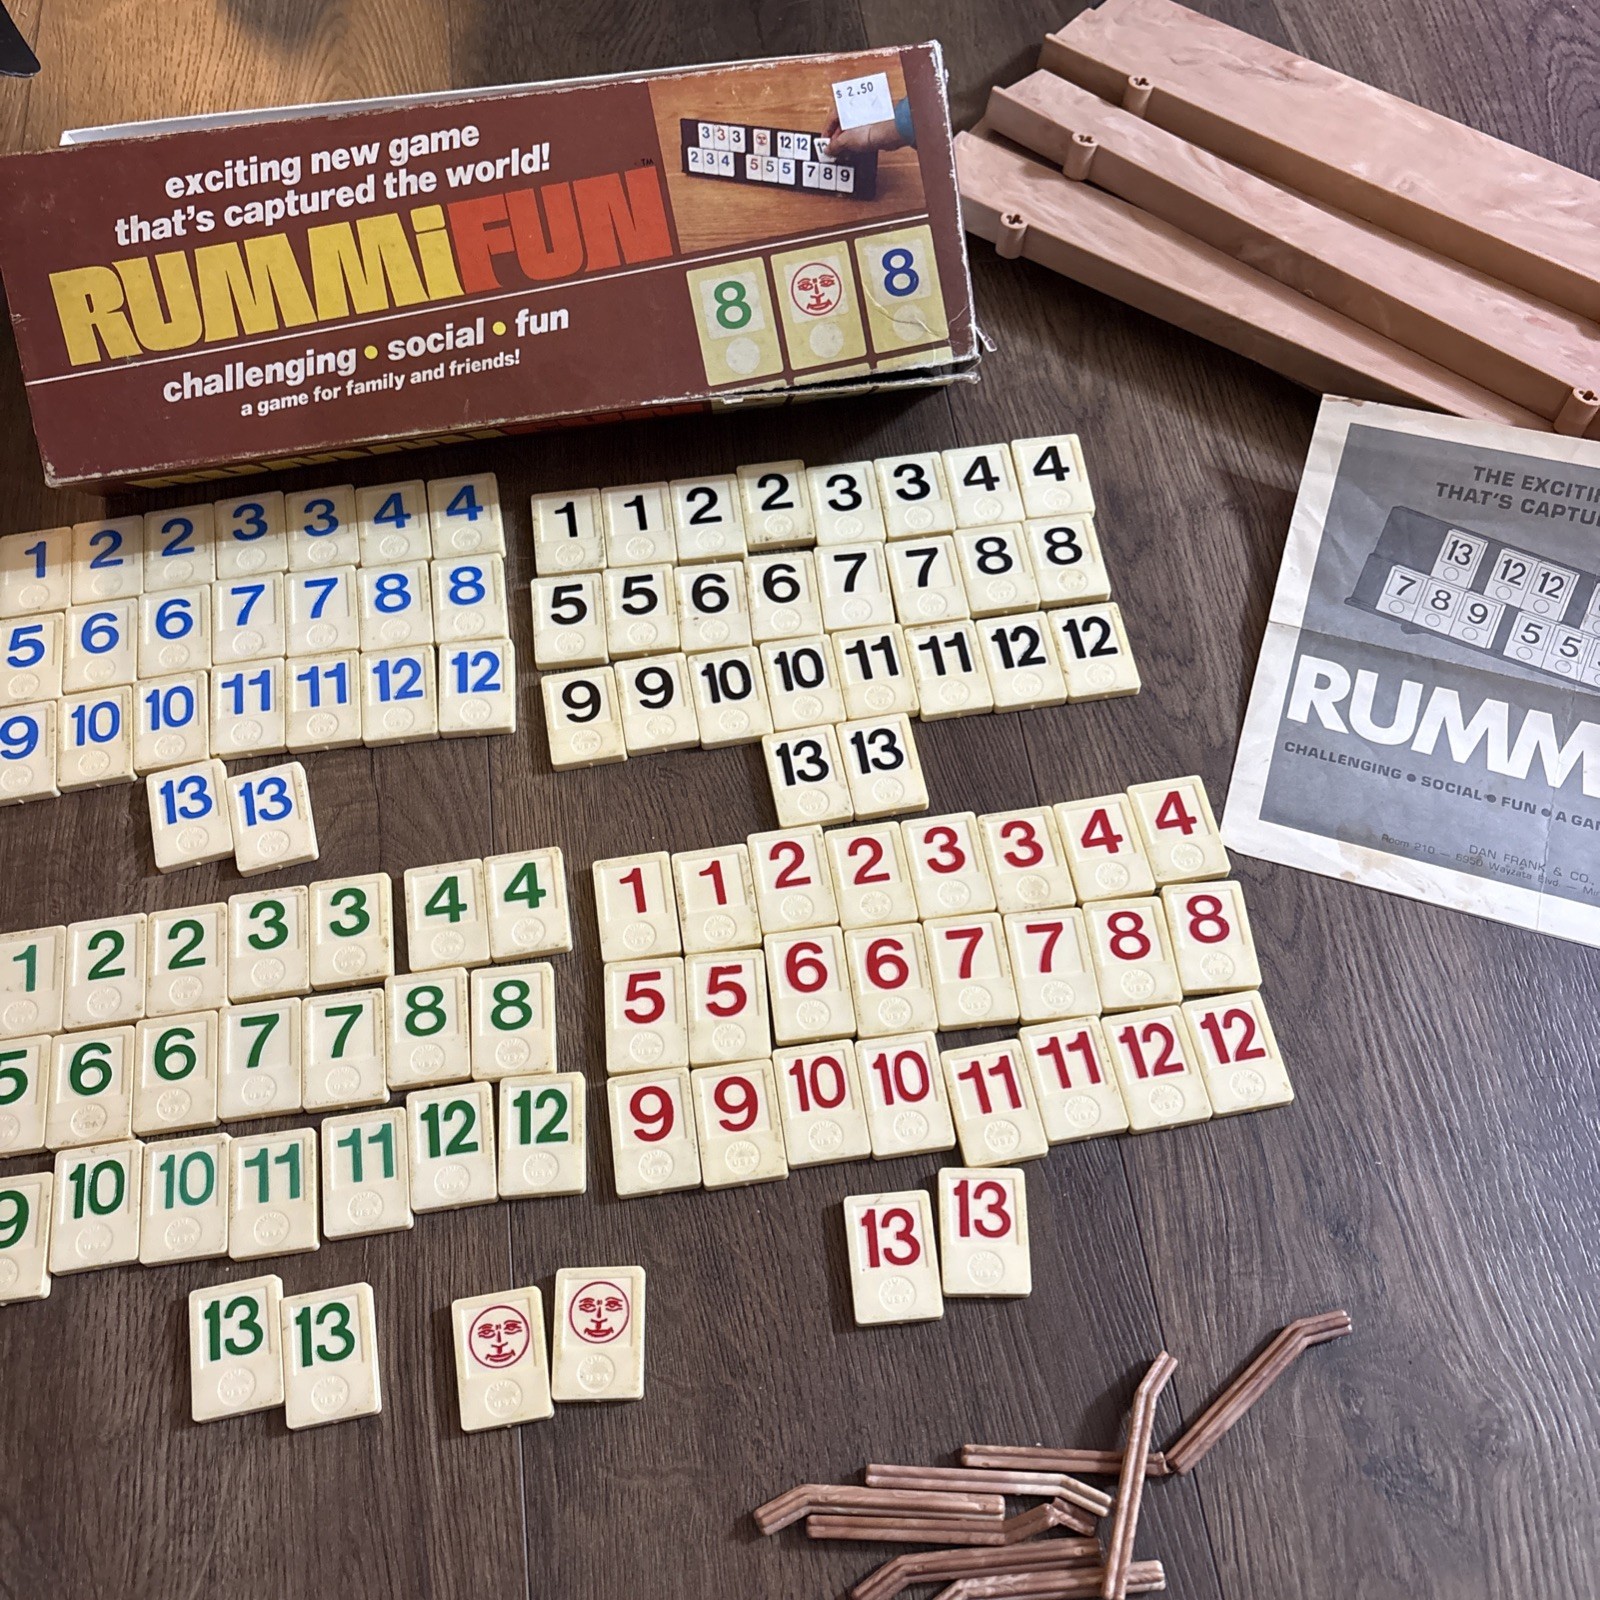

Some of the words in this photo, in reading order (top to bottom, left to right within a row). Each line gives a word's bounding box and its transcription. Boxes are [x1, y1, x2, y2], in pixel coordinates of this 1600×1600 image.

[847, 82, 874, 97] 2.50
[165, 156, 301, 198] exciting
[311, 142, 381, 174] new
[389, 126, 480, 166] game
[691, 151, 699, 163] 2
[706, 153, 715, 165] 3
[721, 155, 730, 167] 4
[750, 158, 759, 171] 5
[766, 161, 775, 172] 5
[782, 162, 791, 174] 5
[807, 165, 816, 178] 7
[823, 167, 833, 180] 8
[840, 169, 850, 182] 9
[702, 126, 710, 139] 3
[717, 128, 726, 141] 3
[732, 130, 741, 143] 3
[779, 136, 792, 149] 12
[796, 138, 808, 151] 12
[115, 206, 216, 245] that's
[224, 174, 376, 227] captured
[383, 169, 438, 199] the
[446, 143, 550, 187] world!
[714, 281, 752, 330] 8
[882, 248, 920, 297] 8
[164, 349, 357, 403] challenging
[388, 317, 485, 360] social
[515, 309, 569, 338] fun
[241, 404, 253, 417] a
[258, 393, 309, 417] game
[313, 386, 342, 403] for
[346, 372, 406, 397] family
[410, 363, 445, 385] and
[449, 349, 520, 377] friends!
[554, 501, 578, 538] 1
[623, 494, 648, 531] 1
[686, 486, 723, 525] 2
[757, 473, 794, 511] 2
[826, 474, 862, 512] 3
[893, 463, 931, 501] 3
[963, 455, 1000, 491] 4
[1033, 446, 1070, 481] 4
[1437, 482, 1513, 509] THAT'S
[1521, 499, 1600, 527] CAPTU
[1474, 466, 1516, 487] THE
[24, 541, 46, 578] 1
[90, 530, 124, 569] 2
[161, 518, 195, 557] 2
[233, 503, 268, 541] 3
[304, 499, 339, 537] 3
[373, 492, 411, 529] 4
[446, 485, 484, 522] 4
[1447, 540, 1473, 566] 13
[1500, 558, 1527, 587] 12
[1538, 571, 1564, 599] 12
[7, 624, 45, 668] 5
[81, 612, 120, 654] 6
[155, 598, 194, 640] 6
[230, 583, 265, 626] 7
[304, 577, 339, 619] 7
[374, 573, 412, 614] 8
[448, 565, 486, 606] 8
[551, 583, 587, 625] 5
[622, 574, 658, 615] 5
[691, 573, 729, 614] 6
[763, 563, 800, 604] 6
[833, 552, 867, 593] 7
[905, 547, 938, 588] 7
[975, 536, 1013, 575] 8
[1044, 527, 1083, 565] 8
[1396, 575, 1417, 596] 7
[1431, 590, 1451, 611] 8
[1467, 603, 1488, 625] 9
[1520, 622, 1544, 645] 5
[1560, 636, 1582, 658] 5
[0, 715, 39, 760] 9
[71, 701, 120, 746] 10
[145, 685, 194, 731] 10
[221, 669, 271, 715] 11
[297, 662, 347, 708] 11
[372, 657, 424, 702] 12
[451, 650, 501, 694] 12
[562, 680, 601, 723] 9
[635, 666, 674, 709] 9
[701, 659, 752, 704] 10
[774, 648, 824, 692] 10
[845, 635, 899, 680] 11
[918, 631, 972, 676] 11
[991, 625, 1046, 669] 12
[1062, 616, 1118, 659] 12
[776, 739, 829, 786] 13
[850, 728, 904, 774] 13
[1284, 741, 1402, 780] CHALLENGING
[1421, 776, 1483, 801] SOCIAL
[1501, 796, 1537, 815] FUN
[1555, 811, 1567, 823] A
[1571, 815, 1600, 831] GA
[159, 775, 213, 825] 13
[239, 776, 293, 827] 13
[1381, 833, 1410, 848] Room
[1414, 842, 1435, 855] 210
[619, 867, 647, 913] 1
[699, 860, 727, 905] 1
[769, 841, 811, 889] 2
[848, 837, 890, 885] 2
[924, 826, 966, 874] 3
[1001, 820, 1044, 868] 3
[1081, 808, 1123, 854] 4
[1155, 791, 1197, 835] 4
[1469, 845, 1497, 860] DAN
[1504, 853, 1546, 873] FRANK
[1553, 866, 1562, 877] &
[13, 945, 36, 991] 1
[88, 930, 125, 980] 2
[168, 920, 205, 969] 2
[248, 900, 288, 950] 3
[330, 888, 370, 937] 3
[425, 876, 467, 922] 4
[504, 862, 546, 908] 4
[624, 971, 665, 1024] 5
[706, 964, 747, 1017] 5
[785, 941, 828, 993] 6
[866, 938, 909, 990] 6
[945, 927, 984, 979] 7
[1026, 922, 1063, 973] 7
[1107, 911, 1151, 961] 8
[1186, 894, 1230, 944] 8
[0, 1049, 27, 1105] 5
[69, 1042, 112, 1096] 6
[154, 1028, 196, 1080] 6
[241, 1014, 279, 1068] 7
[325, 1004, 363, 1058] 7
[405, 985, 446, 1036] 8
[491, 980, 532, 1031] 8
[629, 1085, 674, 1142] 9
[713, 1076, 759, 1132] 9
[789, 1055, 846, 1112] 10
[872, 1050, 930, 1106] 10
[958, 1055, 1022, 1114] 11
[1037, 1031, 1101, 1089] 11
[1119, 1022, 1184, 1079] 12
[1200, 1008, 1266, 1064] 12
[0, 1191, 29, 1249] 9
[69, 1161, 125, 1219] 10
[160, 1151, 215, 1209] 10
[244, 1143, 300, 1203] 11
[339, 1123, 394, 1182] 11
[421, 1100, 478, 1158] 12
[513, 1089, 568, 1144] 12
[861, 1208, 921, 1268] 13
[953, 1179, 1011, 1238] 13
[204, 1296, 263, 1361] 13
[295, 1302, 355, 1367] 13
